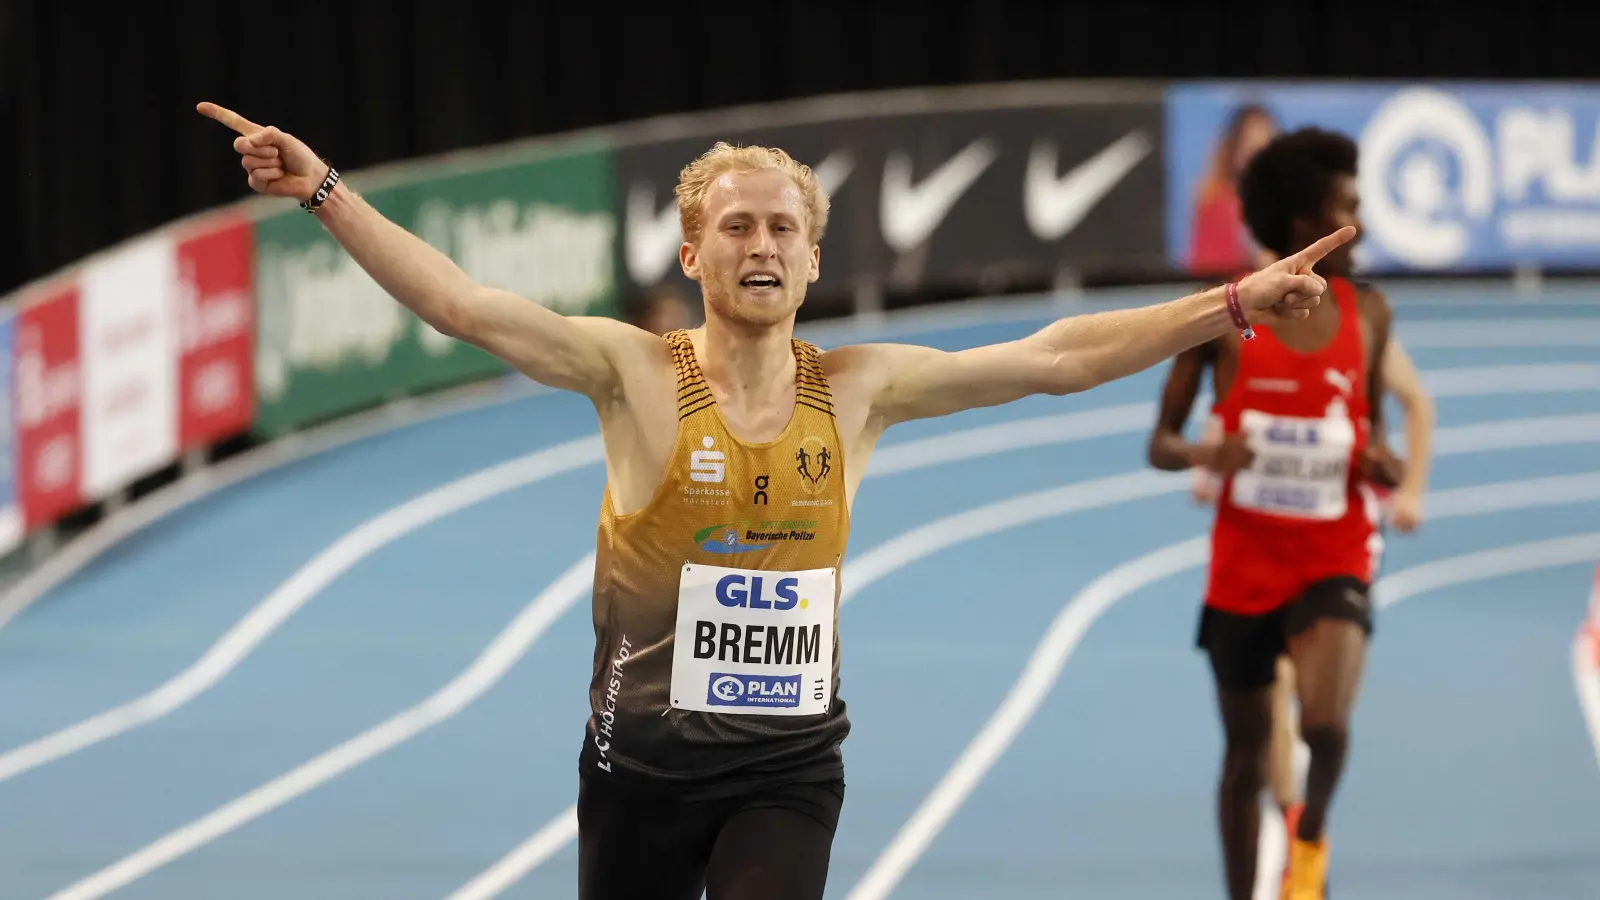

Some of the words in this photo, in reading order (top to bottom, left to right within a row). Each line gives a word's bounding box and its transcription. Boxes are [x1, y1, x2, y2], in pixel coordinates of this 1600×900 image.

[683, 486, 730, 497] Sparkasse
[746, 531, 788, 541] Bayerische
[789, 531, 816, 540] Polizei
[693, 620, 821, 665] BREMM
[600, 634, 632, 738] HÖCHSTADT
[747, 681, 798, 696] PLAN
[813, 678, 824, 700] 110
